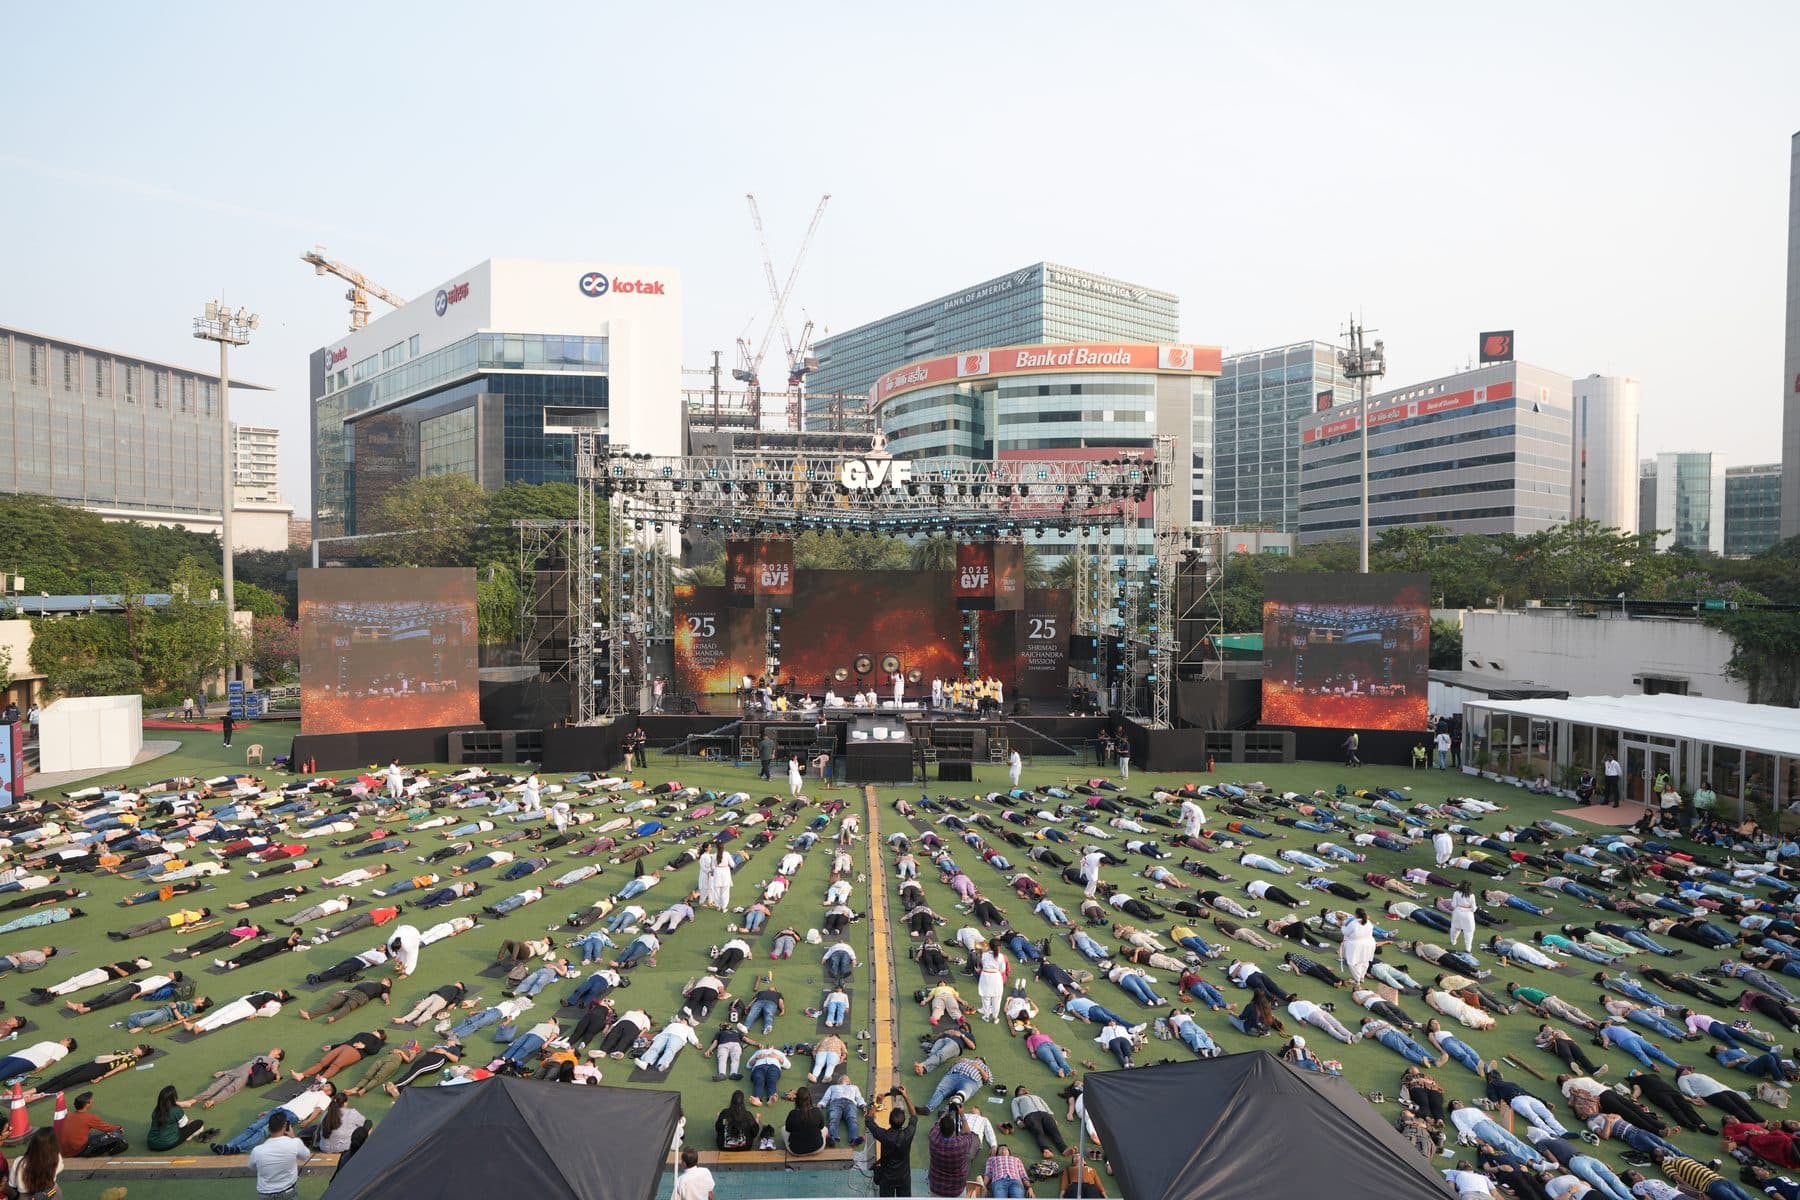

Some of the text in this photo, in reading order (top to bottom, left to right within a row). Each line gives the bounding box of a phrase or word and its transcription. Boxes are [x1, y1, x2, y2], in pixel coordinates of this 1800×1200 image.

[612, 277, 665, 295] kotak
[944, 281, 1012, 309] BANK OF AMERICA
[1055, 272, 1131, 297] BANK OF AMERICA
[1016, 347, 1131, 368] Bank of Baroda
[841, 459, 912, 489] GYF
[761, 563, 789, 571] 2025
[961, 566, 989, 574] 2025
[761, 571, 789, 586] GYF
[961, 574, 989, 589] GYF
[688, 616, 716, 637] 25
[1029, 618, 1056, 639] 25
